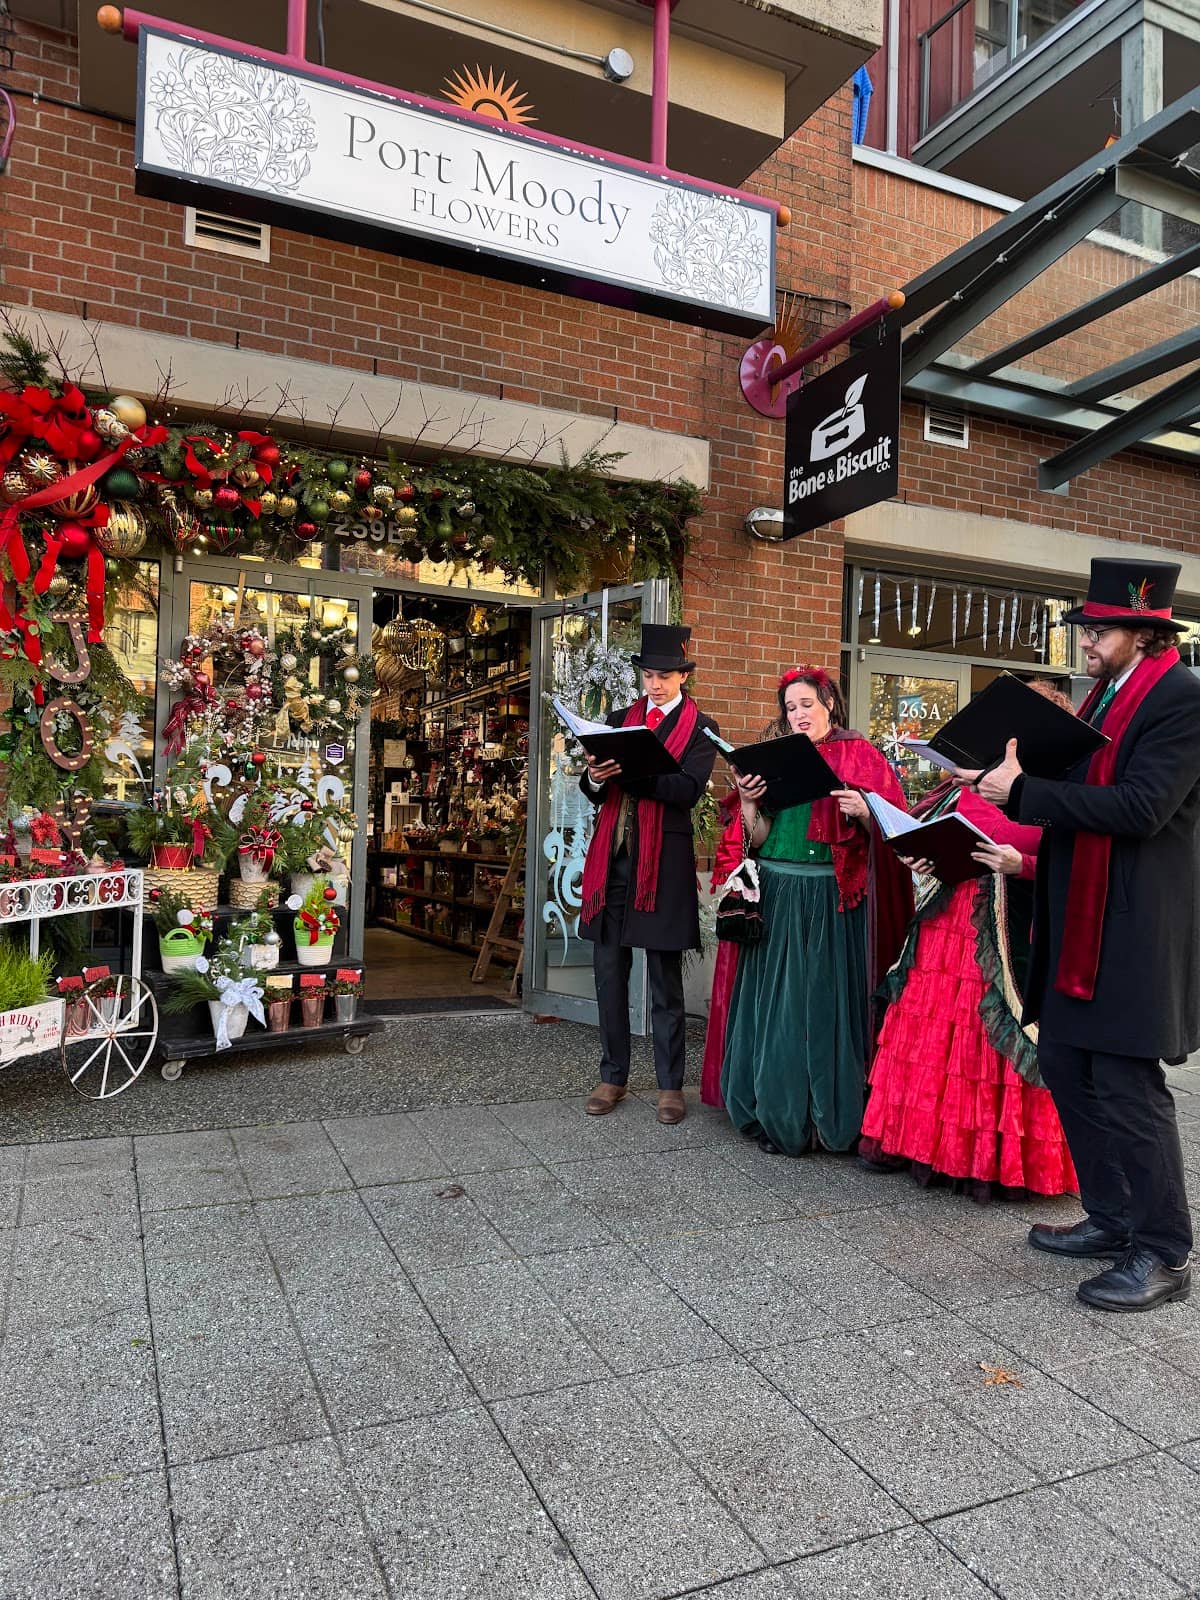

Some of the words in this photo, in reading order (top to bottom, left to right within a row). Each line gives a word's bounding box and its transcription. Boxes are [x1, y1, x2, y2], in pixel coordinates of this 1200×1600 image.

[344, 112, 452, 184] Port
[471, 148, 631, 244] Moody
[410, 187, 560, 248] FLOWERS
[788, 471, 826, 505] Bone
[827, 469, 835, 484] &
[836, 436, 892, 482] Biscuit
[789, 466, 804, 479] the
[899, 700, 941, 720] 265A
